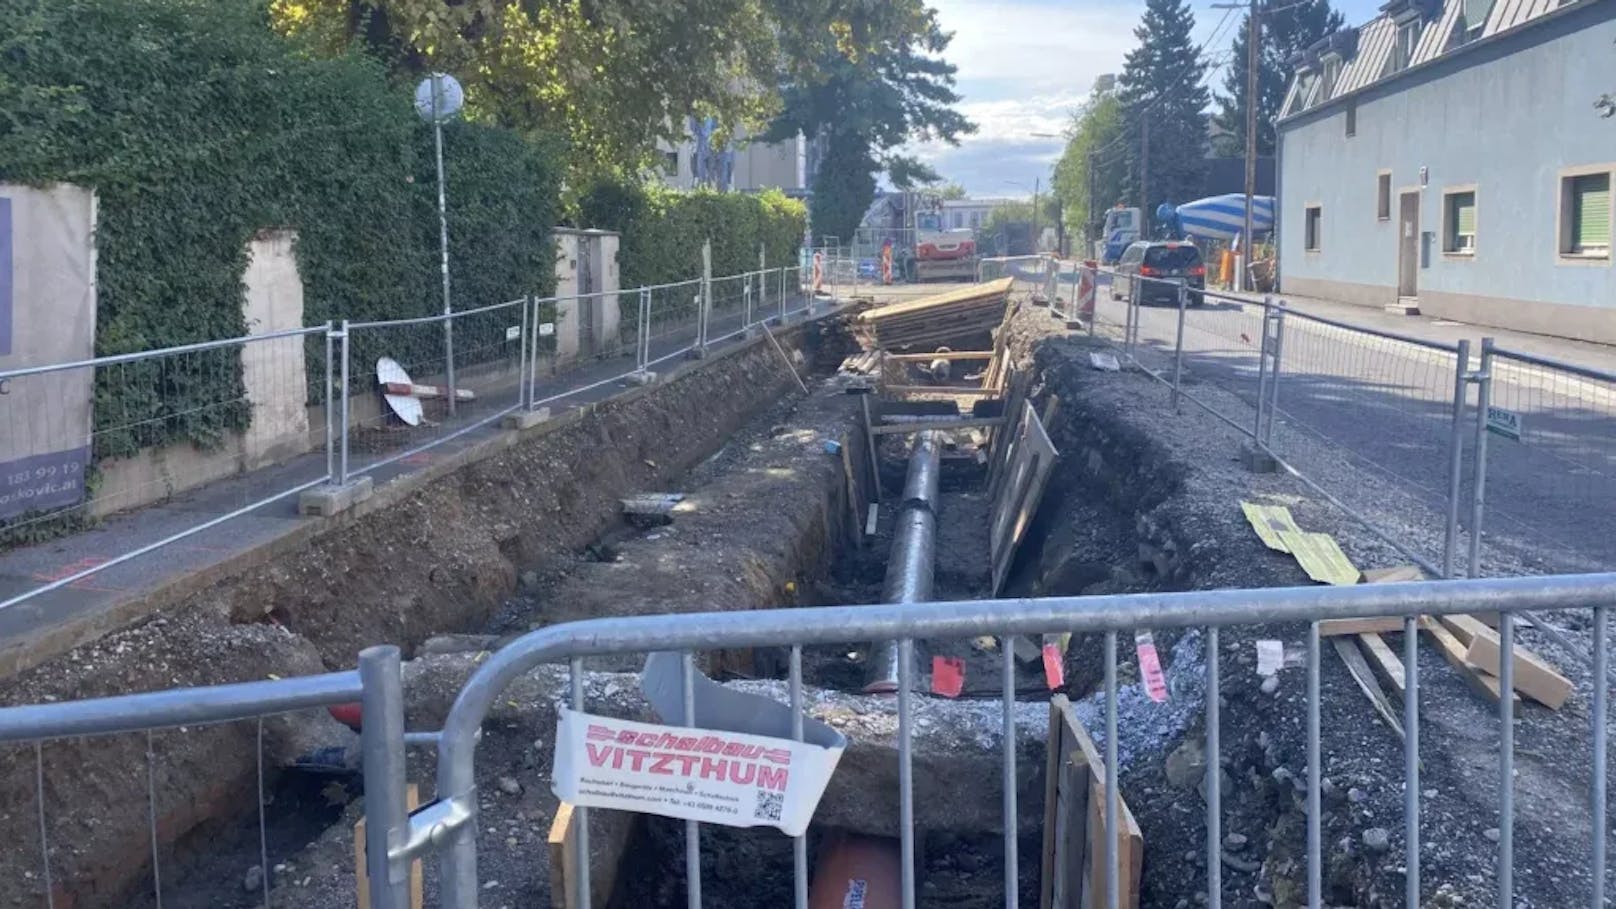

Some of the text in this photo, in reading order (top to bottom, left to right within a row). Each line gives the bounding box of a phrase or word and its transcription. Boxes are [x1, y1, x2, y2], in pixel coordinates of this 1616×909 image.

[35, 465, 57, 480] 99
[62, 461, 80, 475] 19
[585, 743, 790, 793] VITZTHUM
